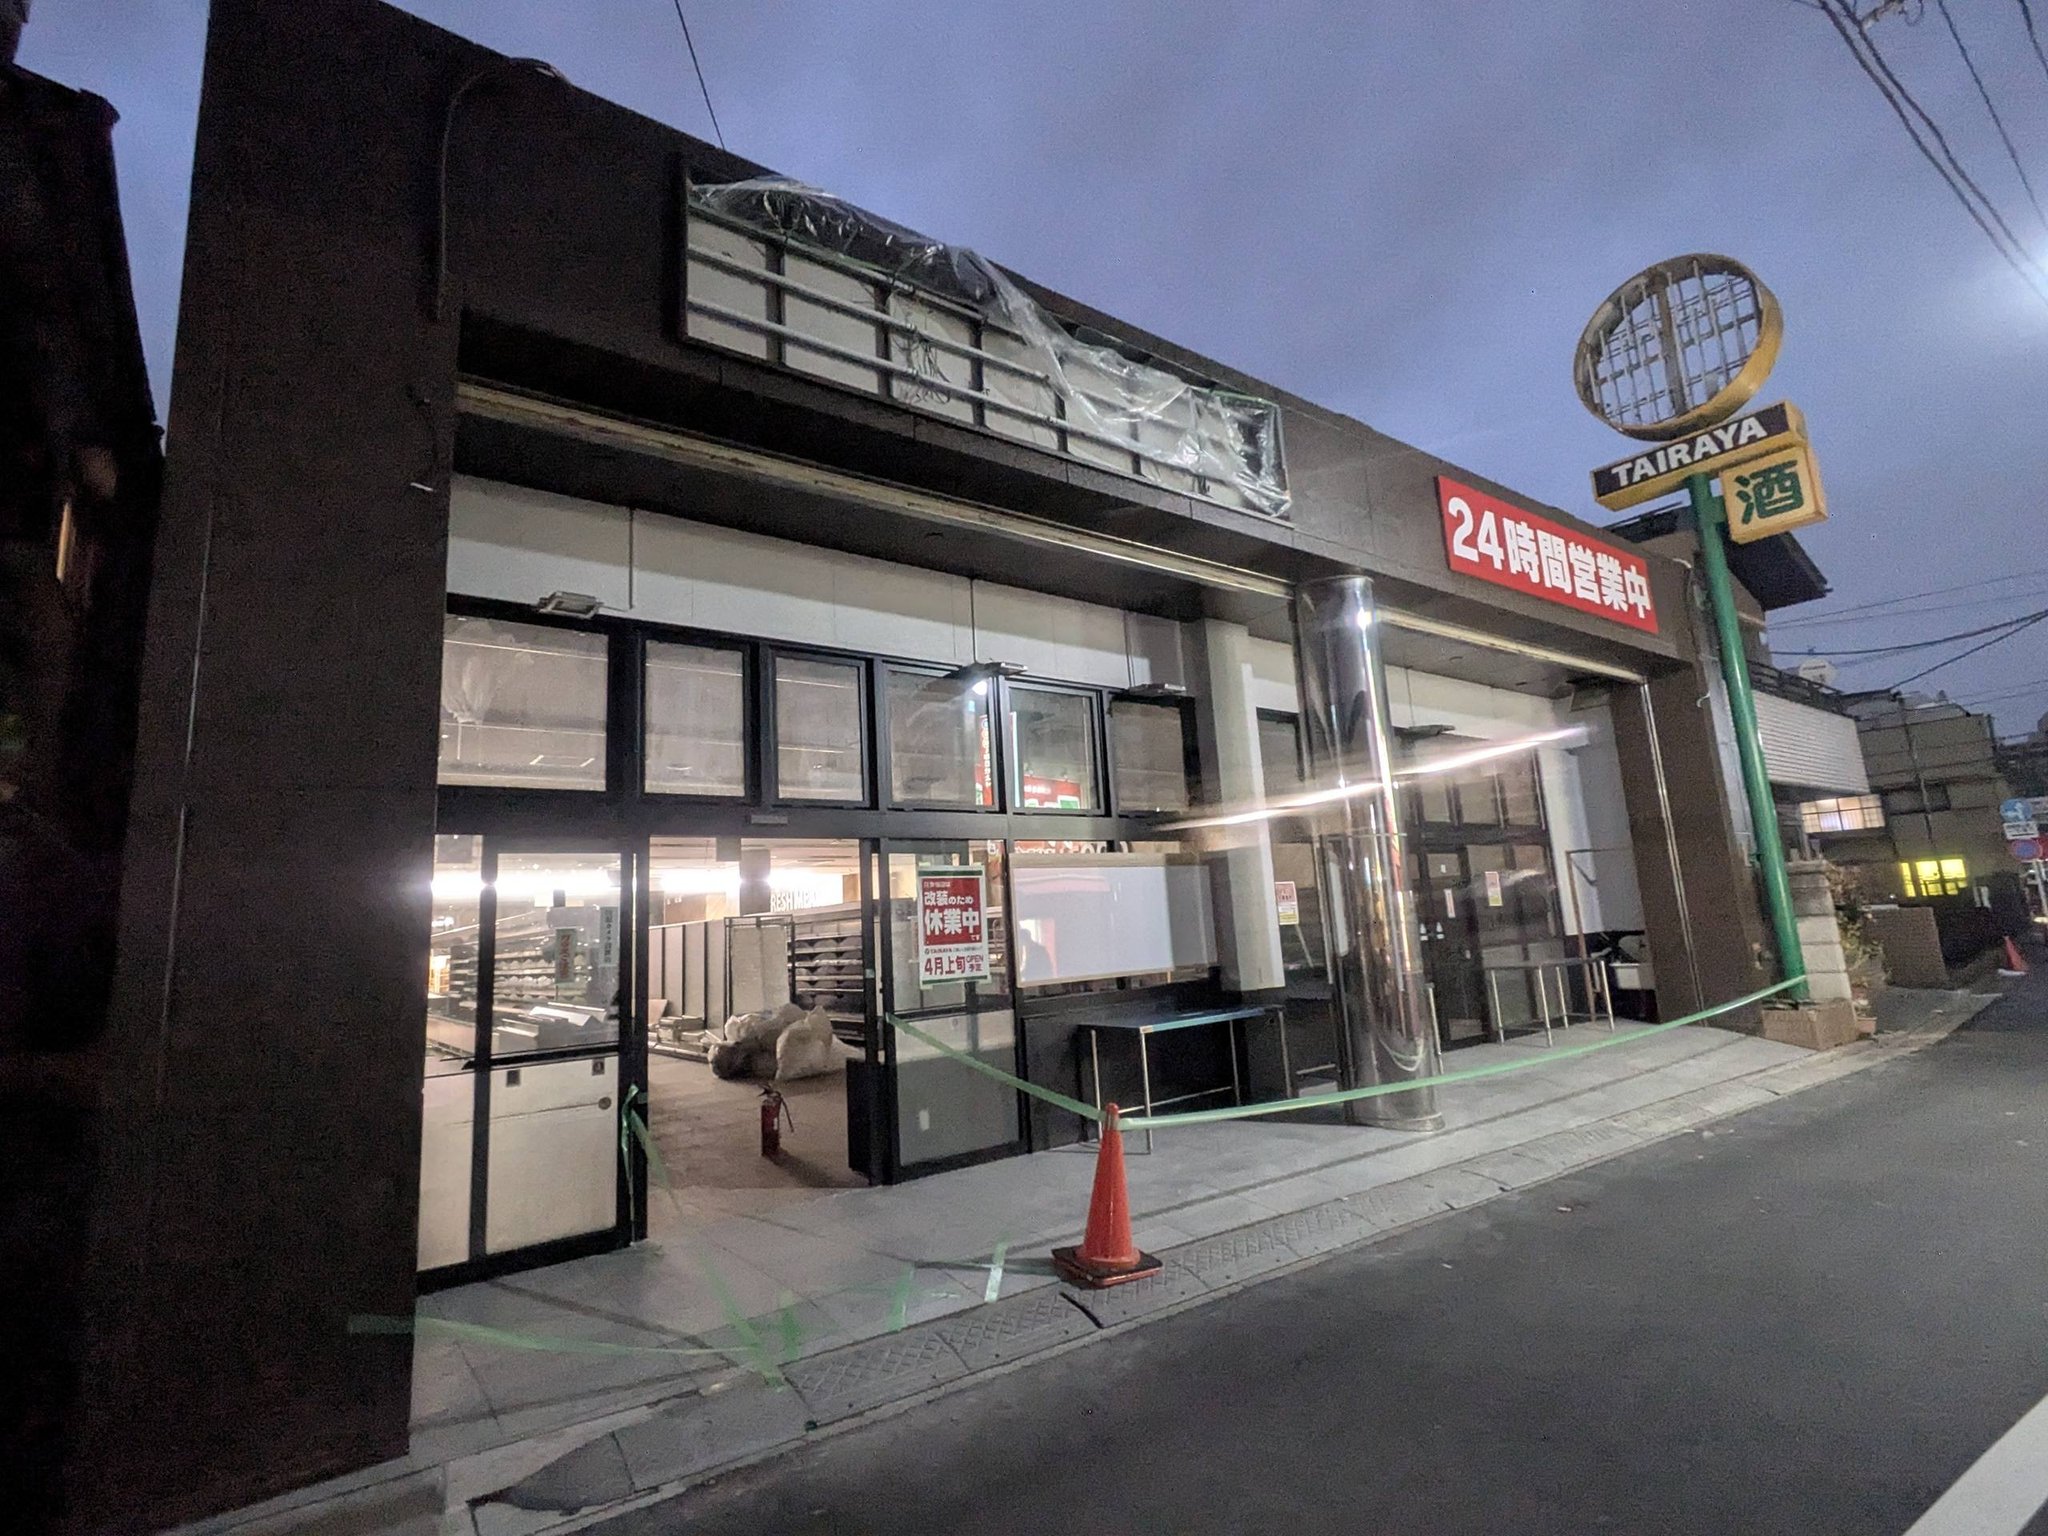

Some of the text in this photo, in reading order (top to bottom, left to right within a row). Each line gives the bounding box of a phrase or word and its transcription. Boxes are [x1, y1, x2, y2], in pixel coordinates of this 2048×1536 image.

[1611, 416, 1768, 487] TAIRAYA
[1734, 460, 1805, 526] 酒
[1448, 496, 1652, 619] 24時間営業中
[770, 892, 793, 913] RESH
[924, 890, 974, 906] 改装のため
[924, 907, 980, 936] 休業中
[924, 956, 966, 976] 4月上旬
[966, 954, 984, 964] OPEN
